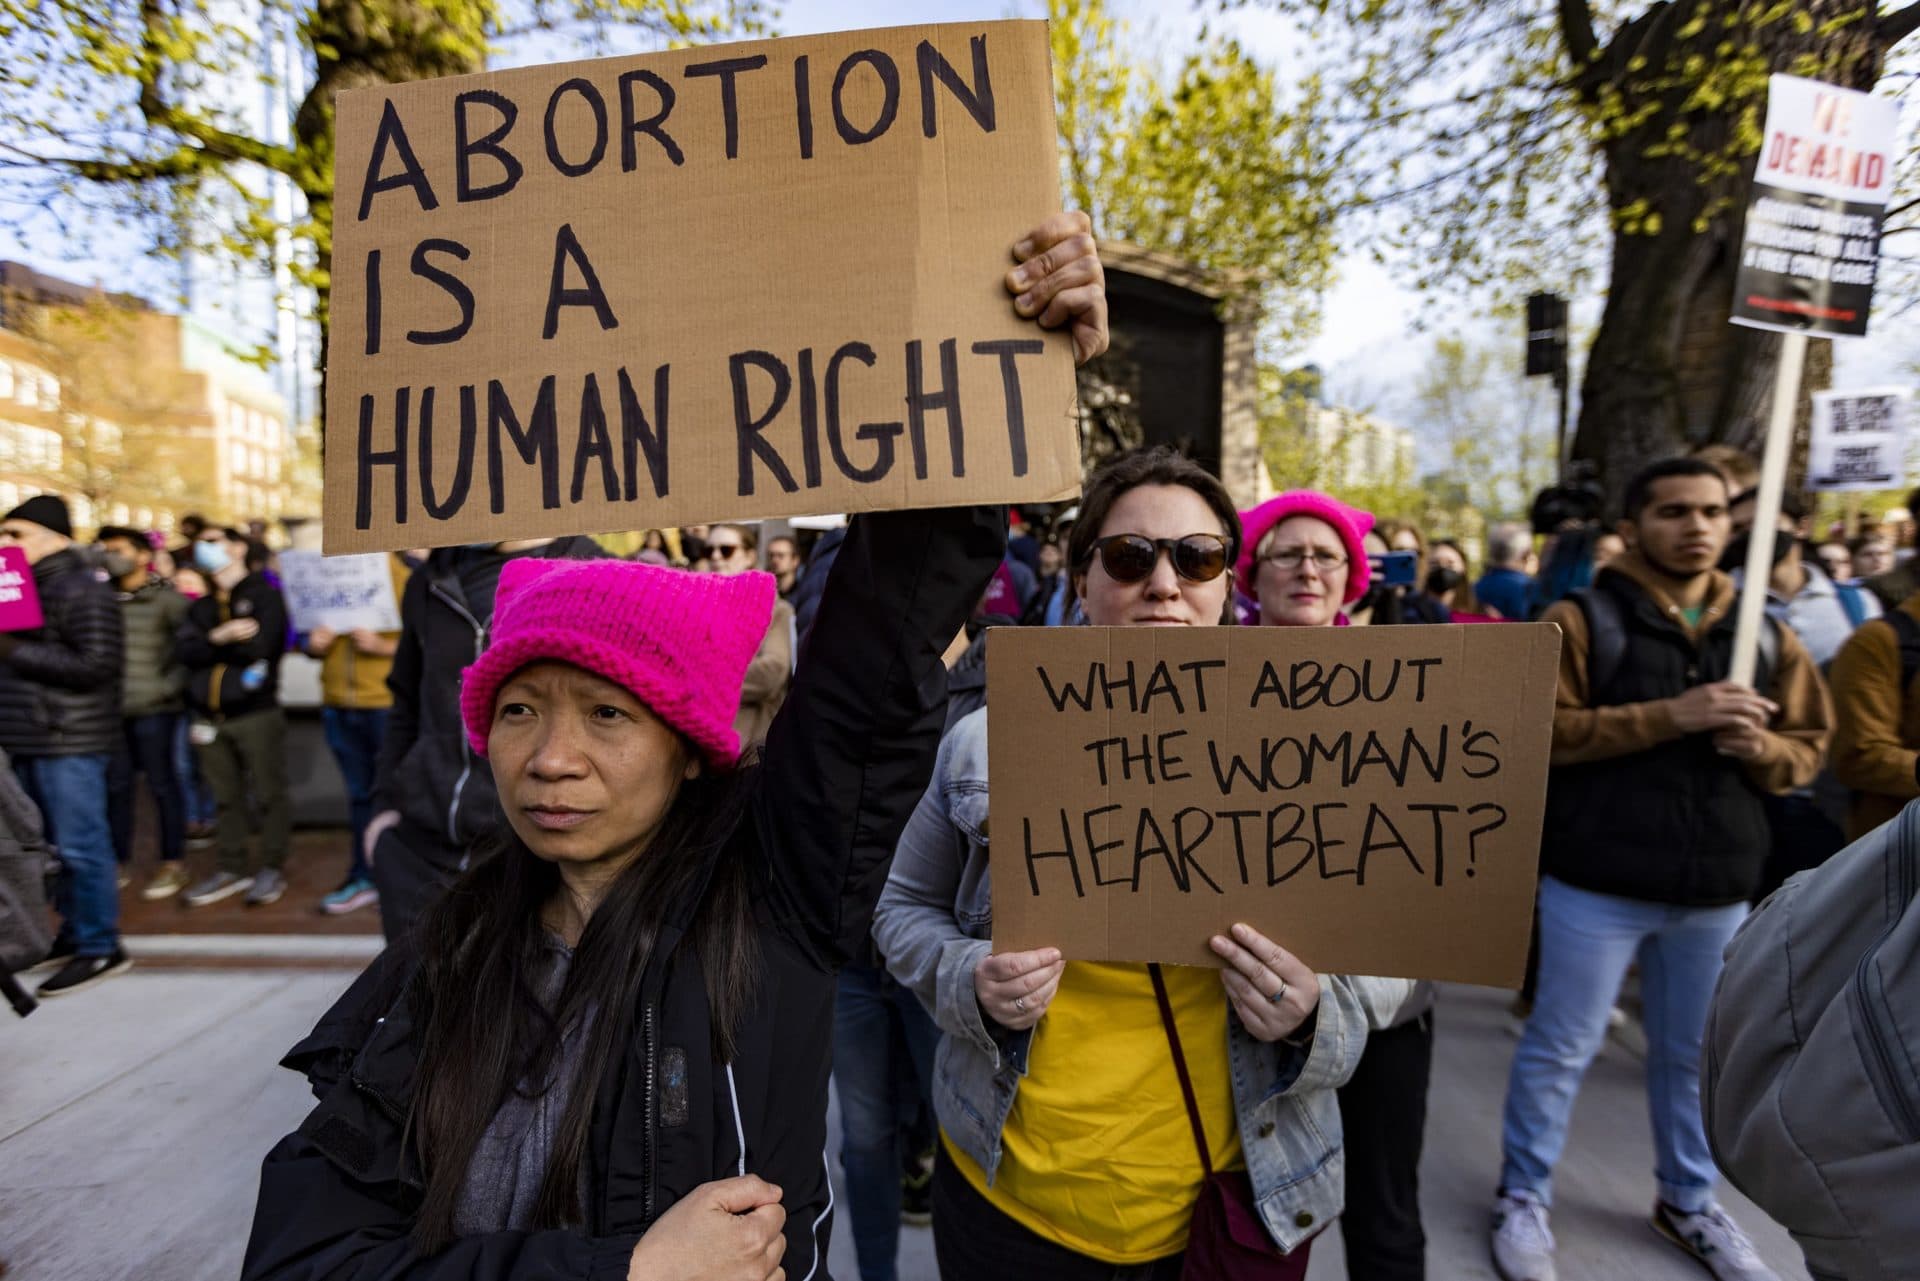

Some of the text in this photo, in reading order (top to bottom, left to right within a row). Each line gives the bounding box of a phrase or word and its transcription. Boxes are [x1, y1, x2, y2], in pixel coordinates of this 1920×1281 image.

[358, 33, 996, 220] ABORTION
[1767, 132, 1885, 189] DEMAND
[366, 223, 618, 354] IS A
[356, 339, 1044, 530] HUMAN RIGHT
[1037, 657, 1442, 714] WHAT ABOUT
[1084, 720, 1500, 794] THE WOMAN'S
[1023, 802, 1507, 897] HEARTBEAT?
